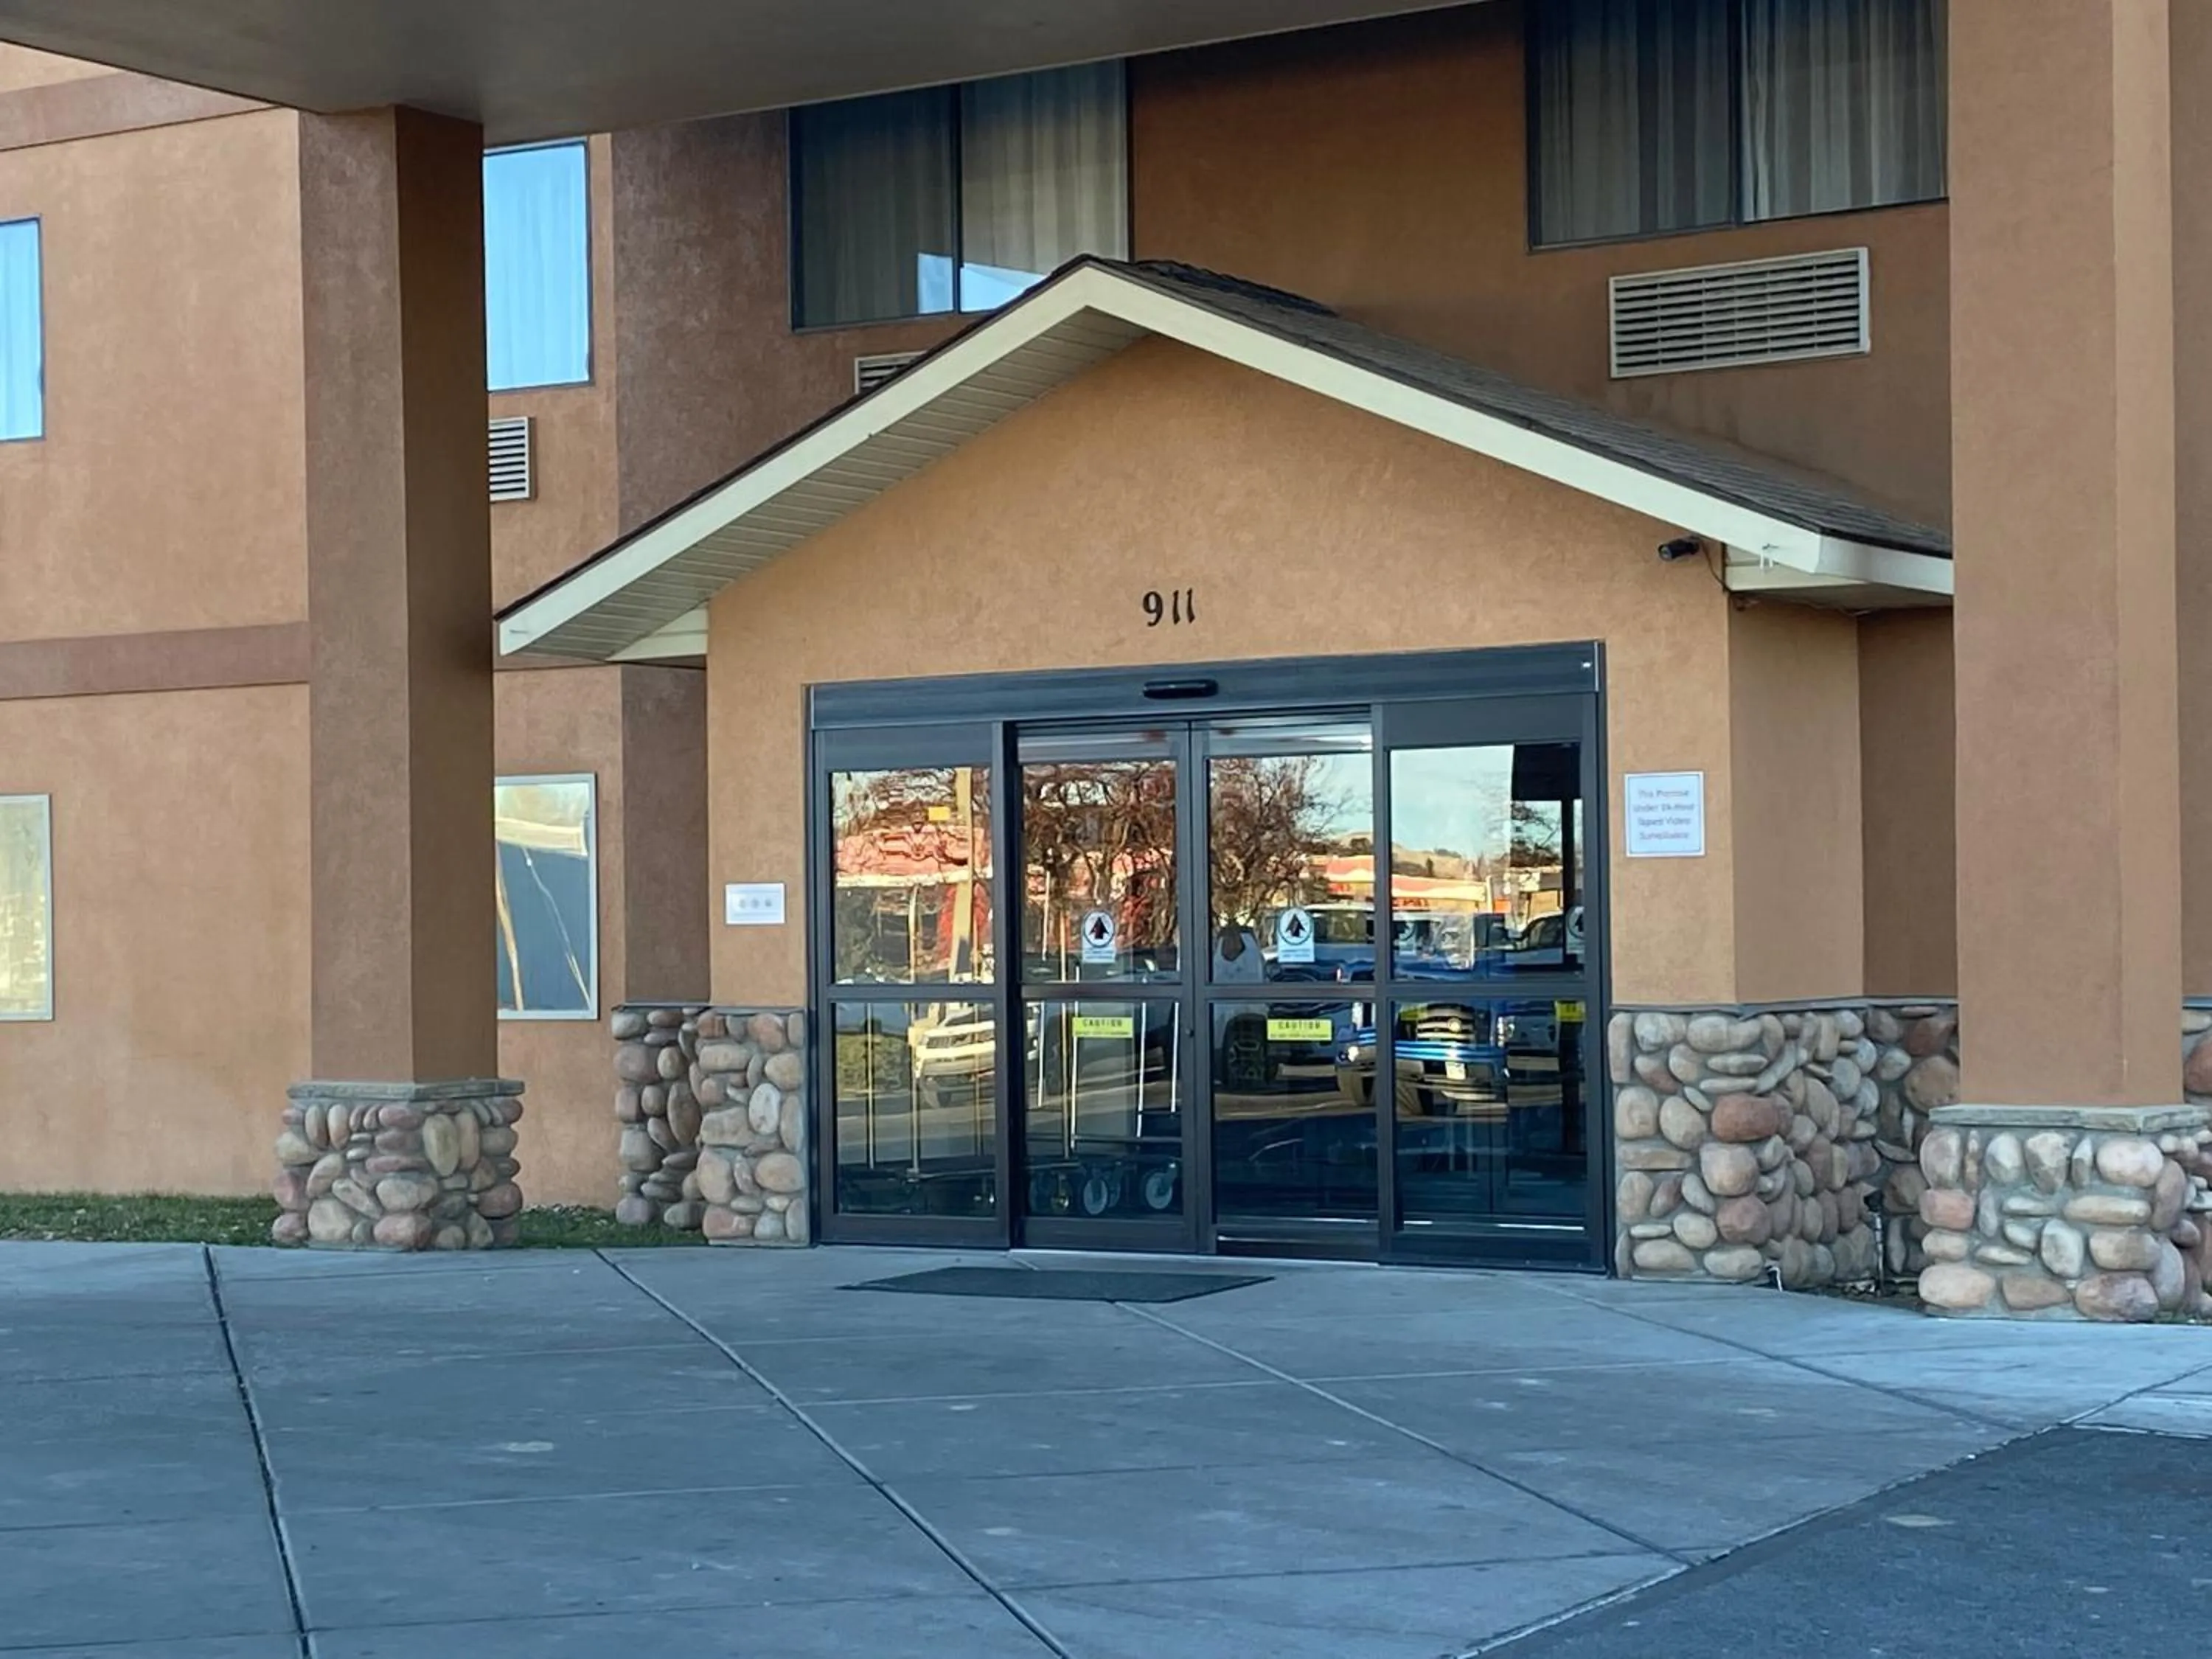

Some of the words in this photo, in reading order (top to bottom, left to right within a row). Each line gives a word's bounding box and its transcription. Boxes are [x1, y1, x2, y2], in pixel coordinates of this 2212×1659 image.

[1143, 588, 1195, 626] 911
[1082, 1019, 1122, 1027] CAUTION
[1279, 1021, 1321, 1030] CAUTION
